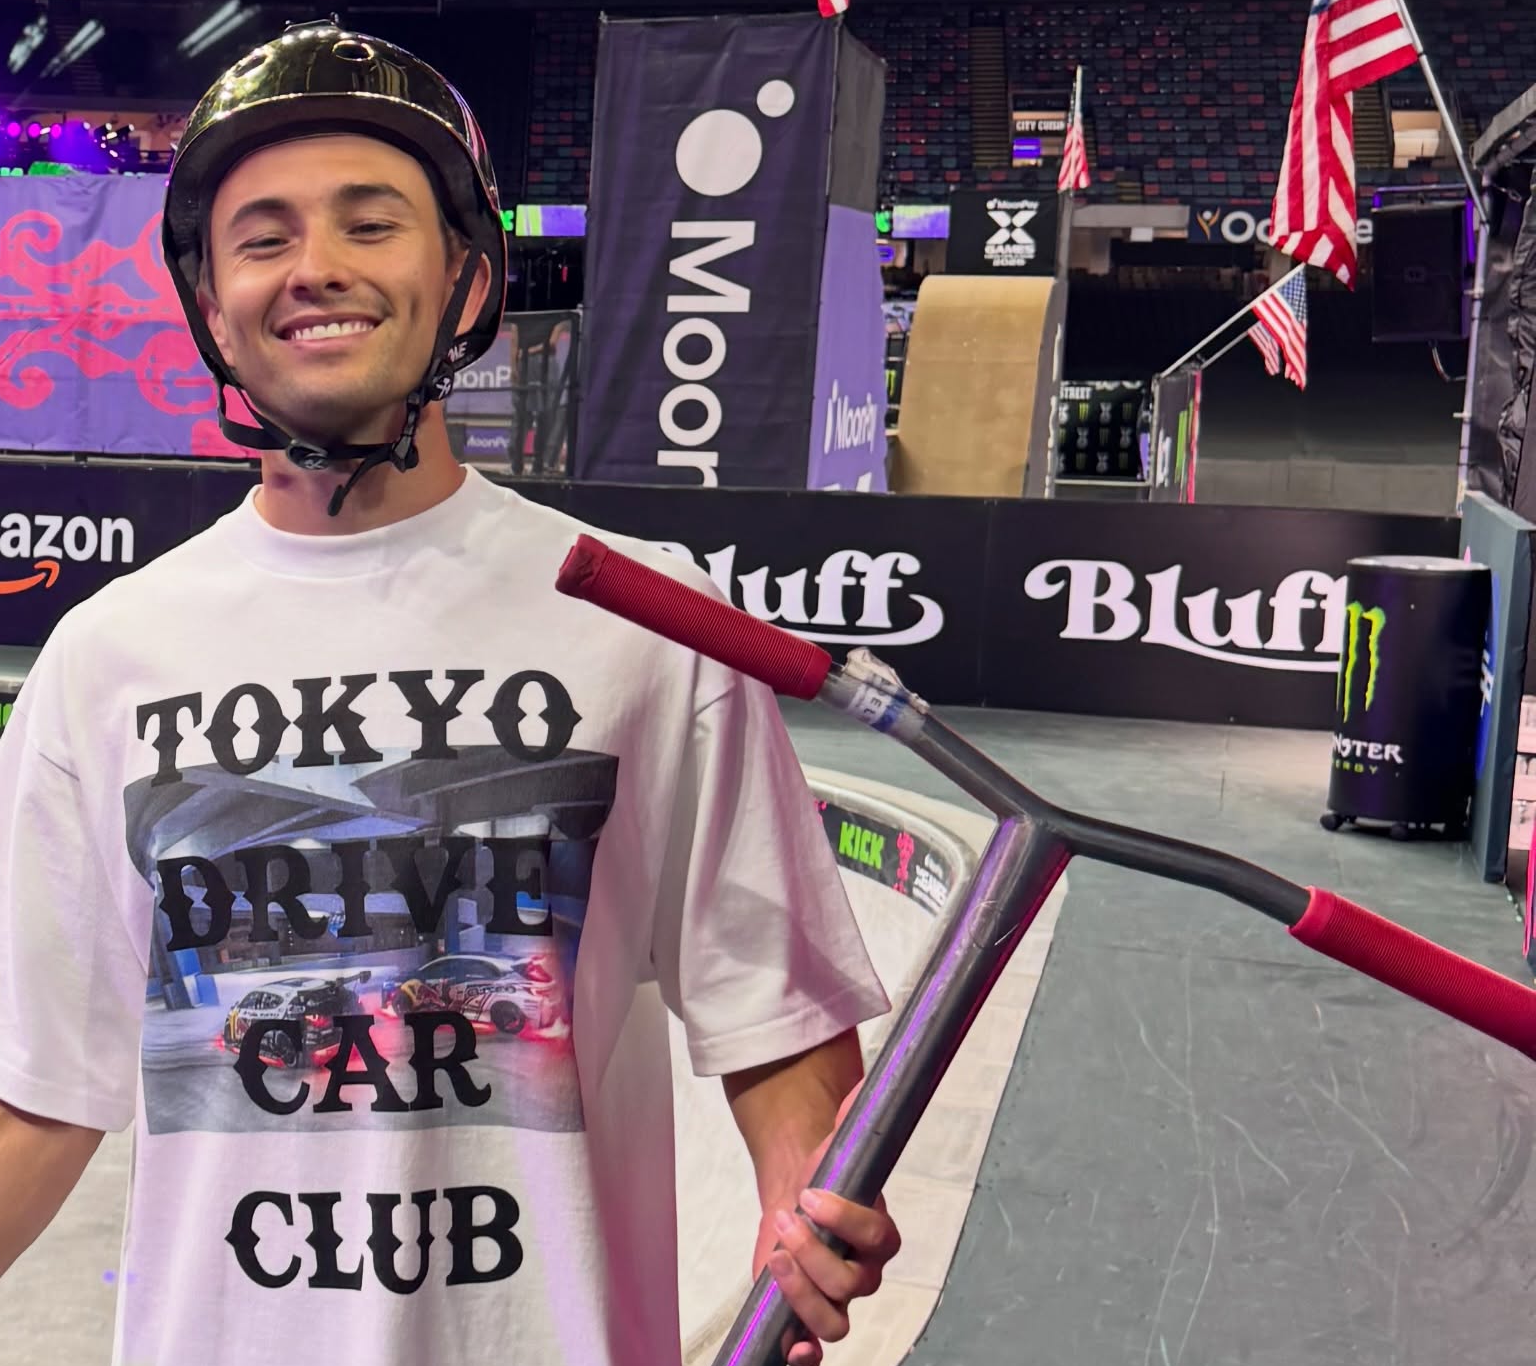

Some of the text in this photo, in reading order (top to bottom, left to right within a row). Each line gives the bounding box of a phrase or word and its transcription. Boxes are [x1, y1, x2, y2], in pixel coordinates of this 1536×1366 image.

[136, 668, 583, 788] TOKYO
[156, 836, 554, 952] DRIVE
[838, 821, 885, 870] KICK
[233, 1010, 492, 1115] CAR
[224, 1184, 524, 1296] CLUB
